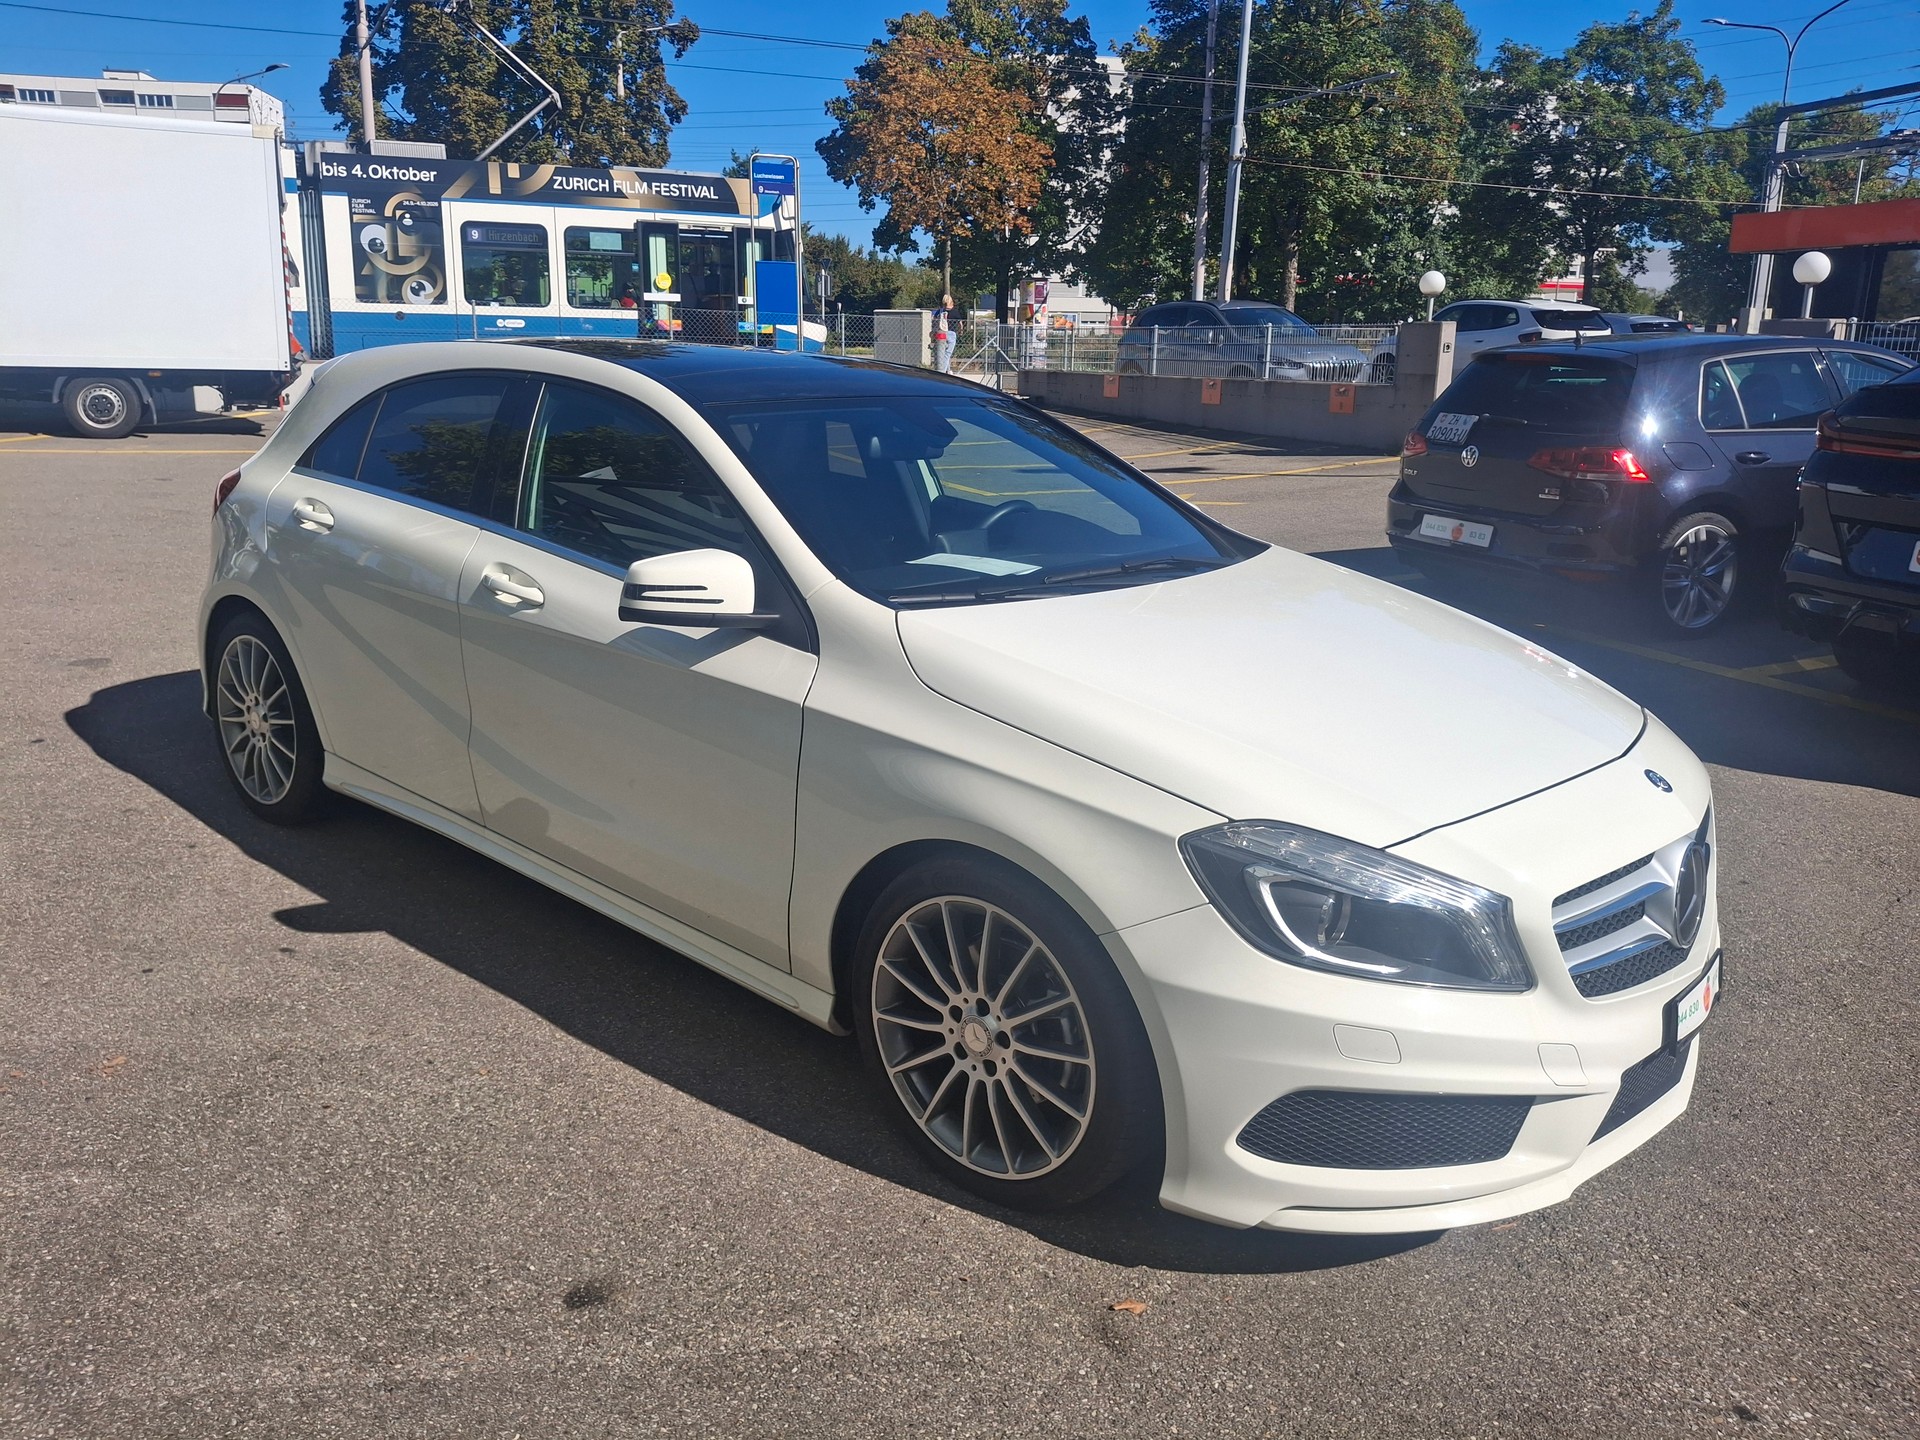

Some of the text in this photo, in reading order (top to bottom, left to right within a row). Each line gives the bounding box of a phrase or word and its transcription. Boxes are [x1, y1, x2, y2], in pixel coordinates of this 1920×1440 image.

[322, 161, 347, 177] bis
[552, 176, 719, 200] ZURICH FILM FESTIVAL
[758, 185, 764, 194] 9
[471, 229, 539, 243] 9 Hirzenbach
[1448, 414, 1462, 426] ZH
[1688, 999, 1700, 1018] 830
